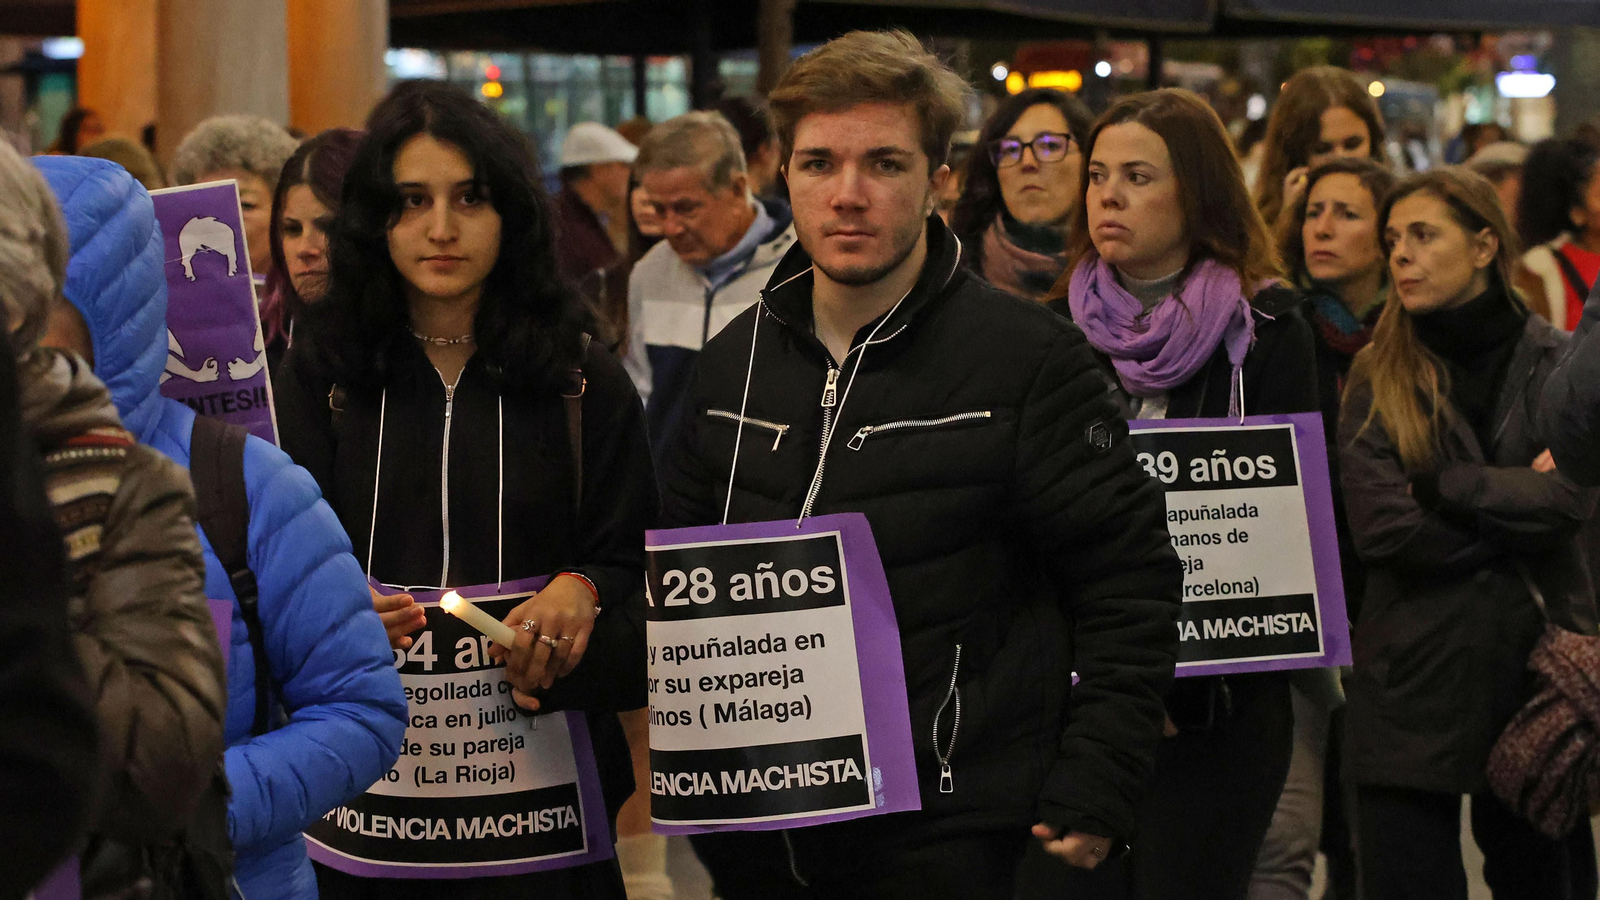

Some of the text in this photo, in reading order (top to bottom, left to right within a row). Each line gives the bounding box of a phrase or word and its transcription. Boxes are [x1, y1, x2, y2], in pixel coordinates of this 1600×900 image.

[177, 386, 268, 416] NTES!!
[1136, 450, 1277, 484] 39 años
[1167, 503, 1259, 525] apuñalada
[1227, 528, 1249, 544] de
[662, 566, 716, 607] 28
[729, 562, 836, 601] años
[1203, 612, 1315, 640] MACHISTA
[649, 632, 825, 666] y apuñalada en
[664, 678, 691, 694] su
[698, 664, 805, 694] expareja
[445, 713, 471, 728] en
[478, 705, 517, 730] julio
[399, 732, 525, 759] de su pareja
[414, 766, 448, 788] (La
[456, 761, 516, 785] Rioja)
[720, 757, 863, 795] MACHISTA
[336, 805, 579, 841] VIOLENCIA MACHISTA
